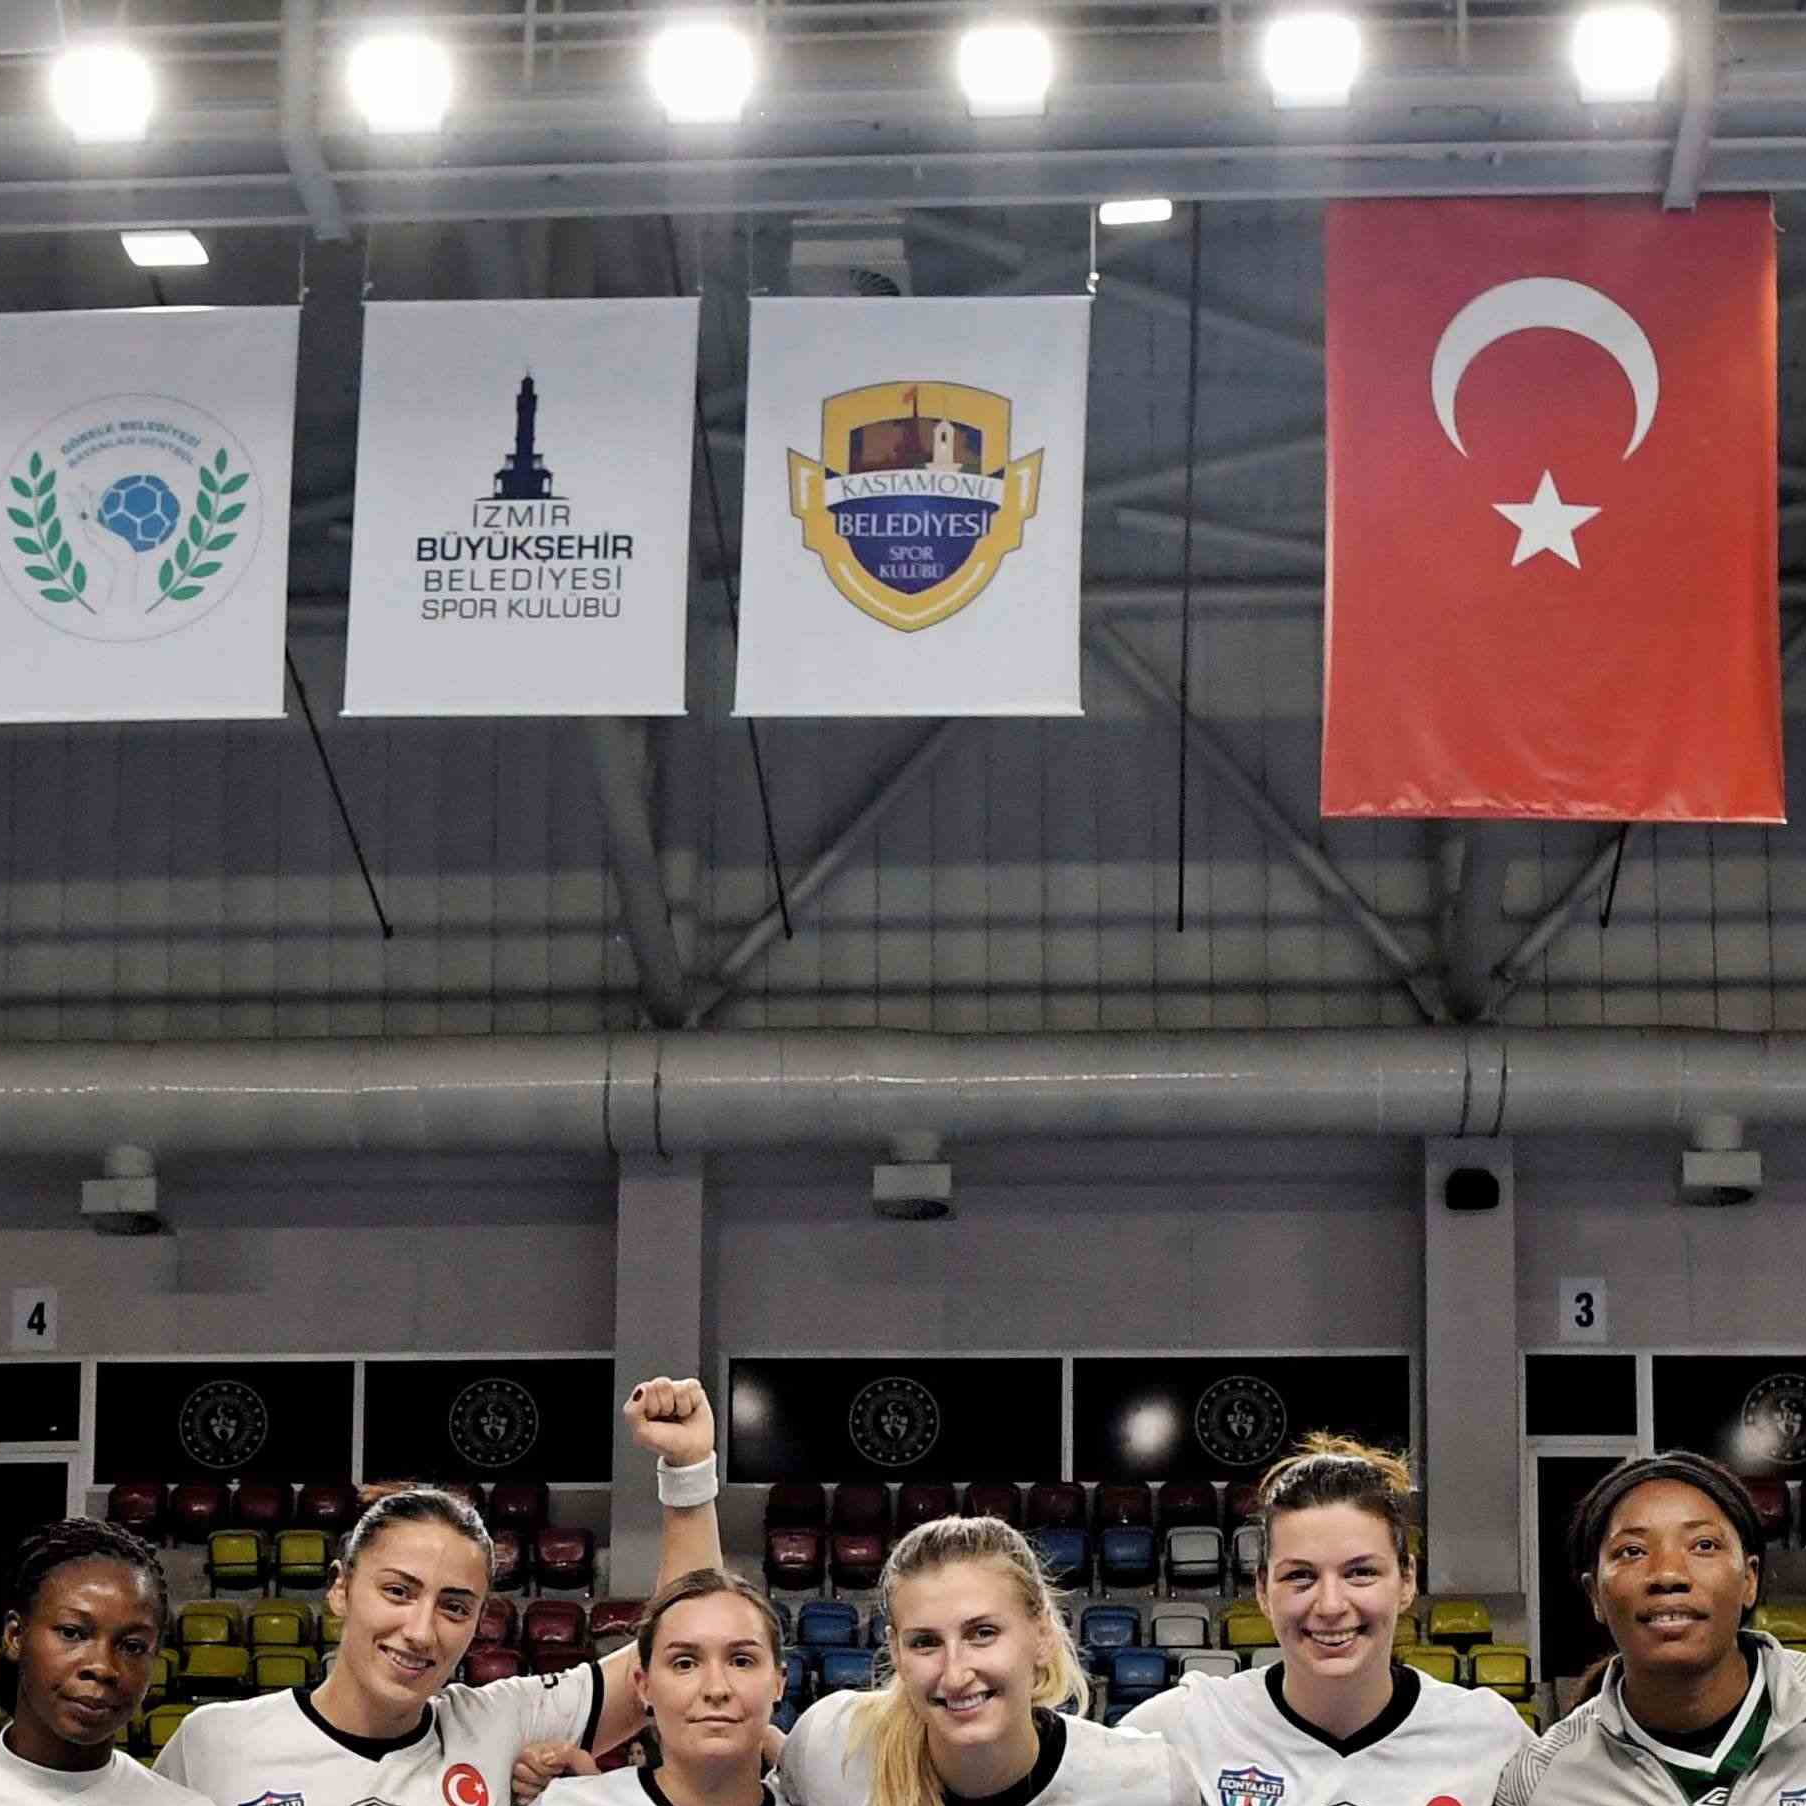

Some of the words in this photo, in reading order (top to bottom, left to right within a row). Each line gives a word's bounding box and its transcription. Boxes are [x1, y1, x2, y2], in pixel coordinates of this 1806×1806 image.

[842, 473, 993, 499] KASTAMONU
[472, 503, 570, 528] İZMİR
[838, 509, 988, 537] BELEDİYESİ
[416, 530, 633, 563] BÜYÜKŞEHİR
[889, 546, 934, 561] SPOR
[424, 564, 622, 592] BELEDİYESİ
[421, 598, 497, 620] SPOR
[507, 592, 621, 619] KULÜBÜ
[26, 1302, 47, 1335] 4
[1574, 1291, 1595, 1327] 3
[1221, 1778, 1282, 1796] KONYAALTI
